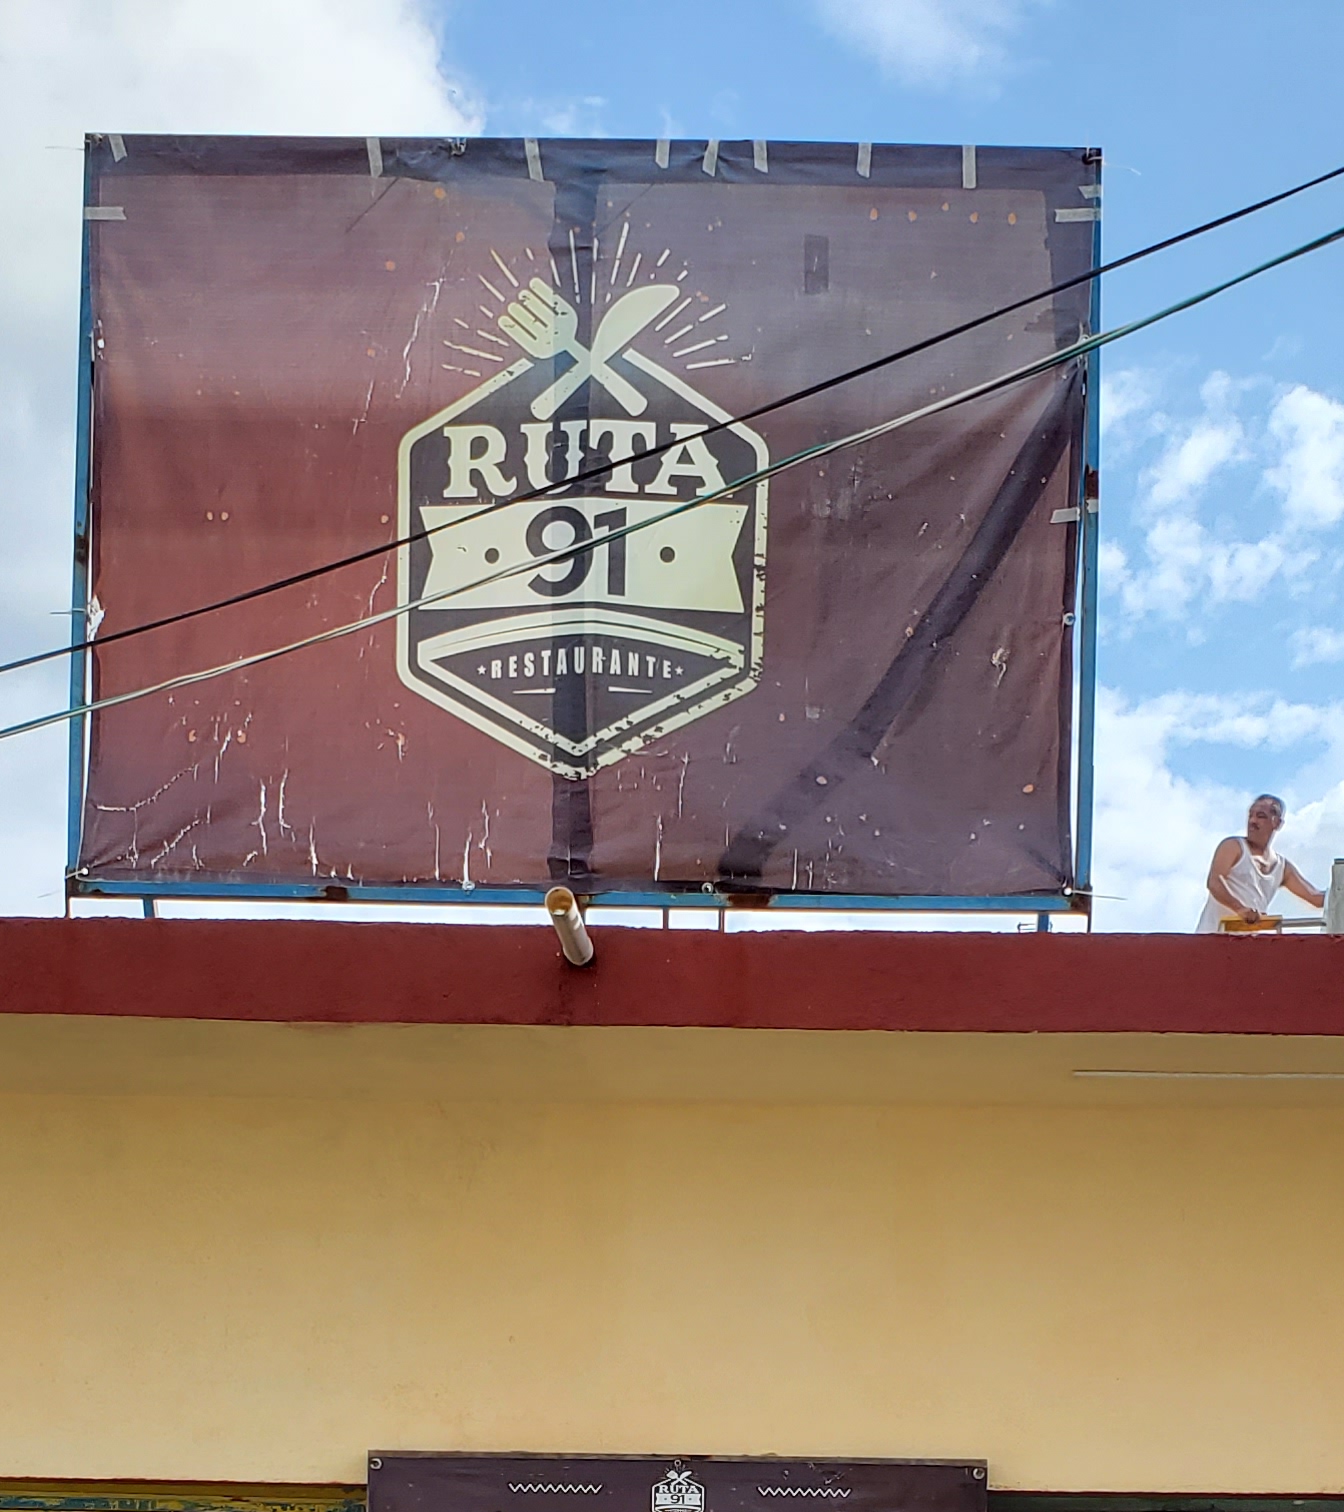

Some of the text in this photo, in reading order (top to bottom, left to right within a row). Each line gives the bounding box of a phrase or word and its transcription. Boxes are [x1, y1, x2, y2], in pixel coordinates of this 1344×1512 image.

[443, 420, 734, 498] RUTA
[525, 505, 628, 598] 91
[490, 646, 673, 680] RESTAURANTE
[659, 1485, 699, 1494] RUTA
[670, 1494, 685, 1503] 91
